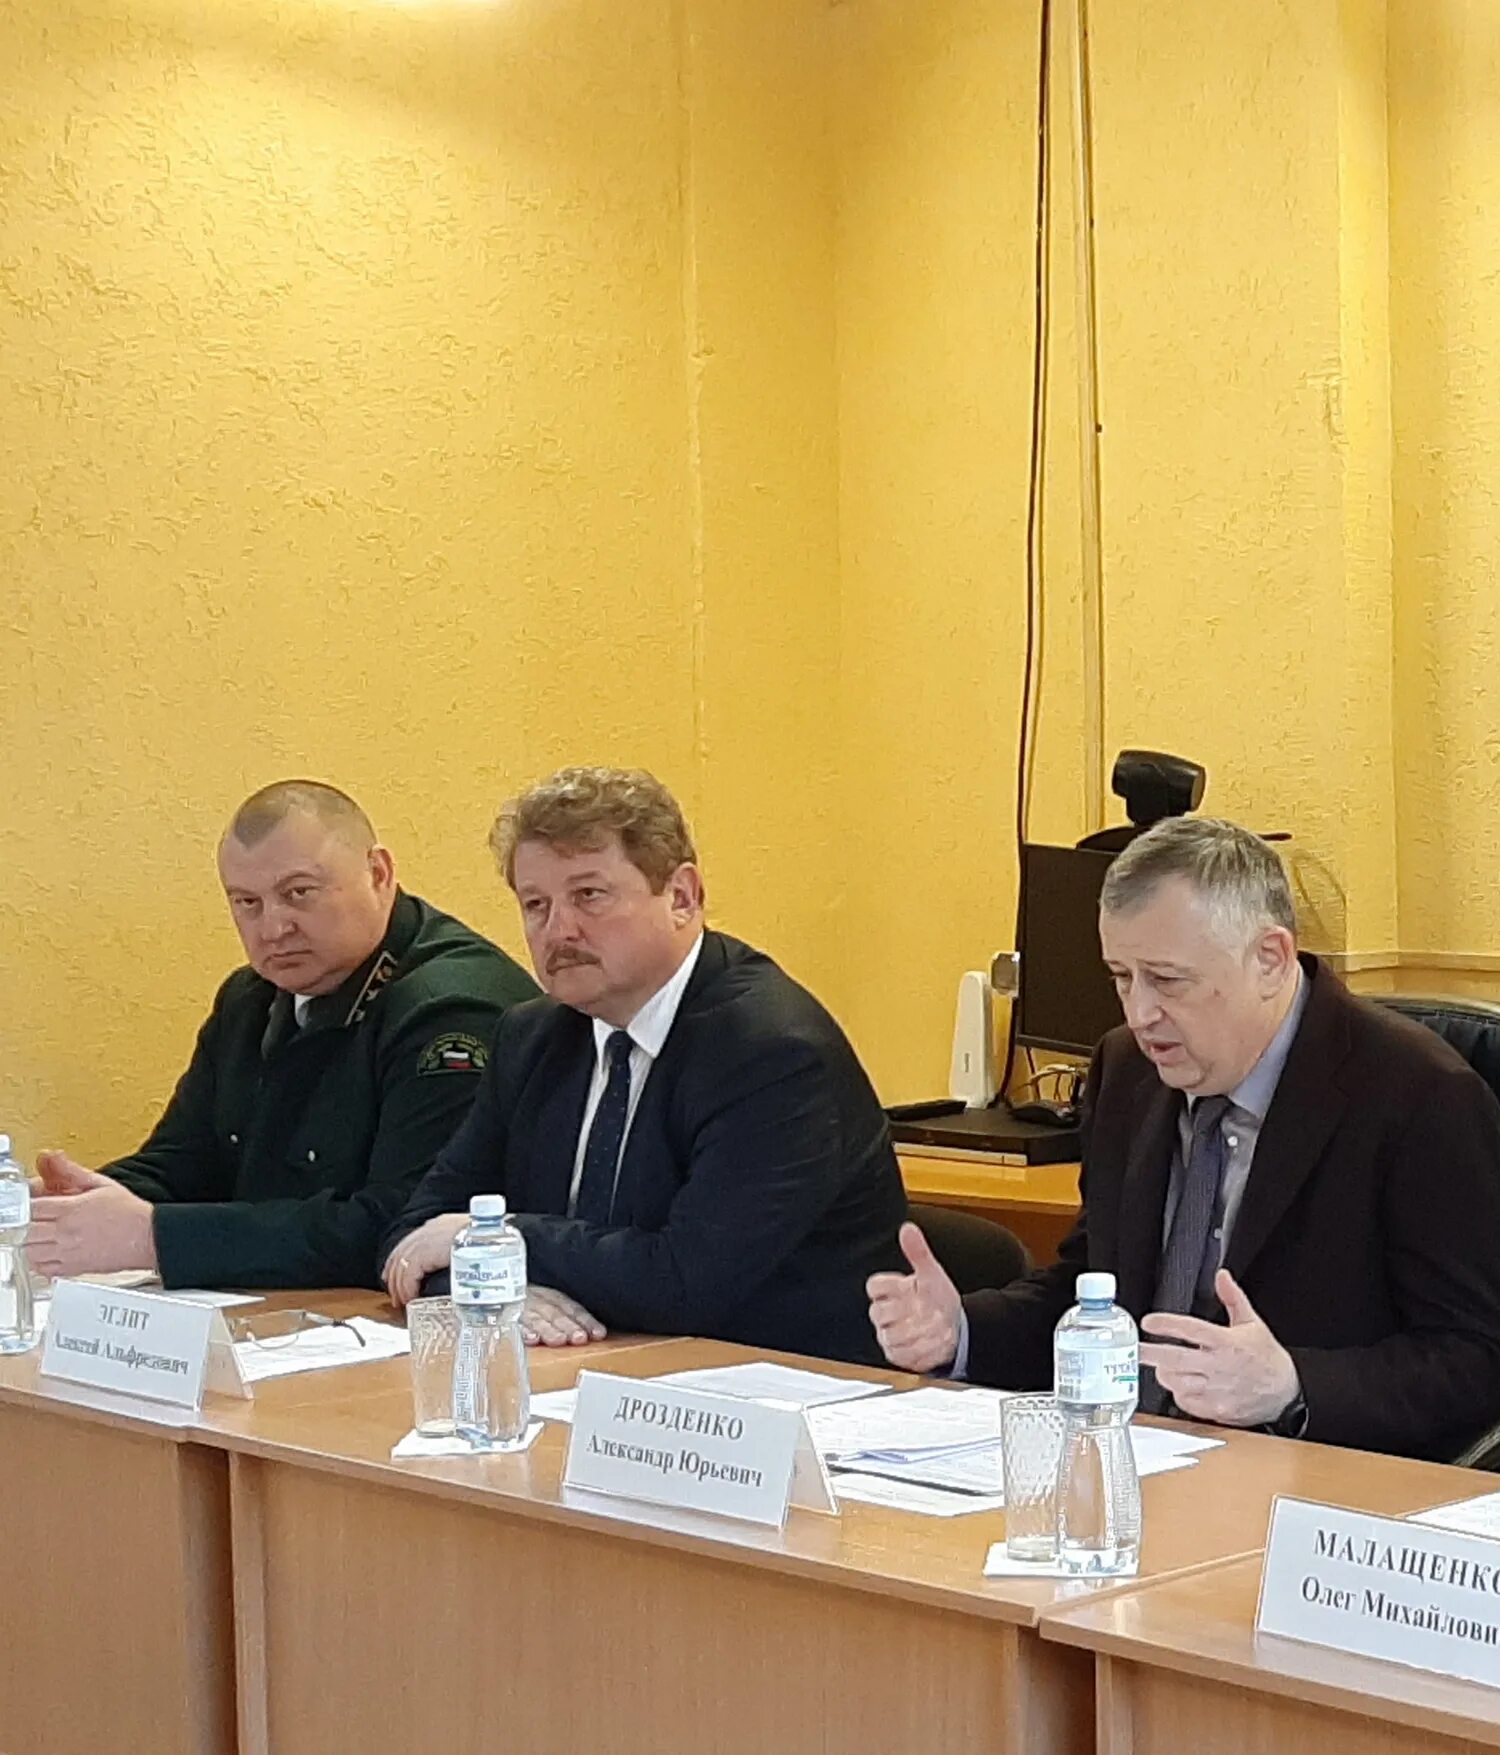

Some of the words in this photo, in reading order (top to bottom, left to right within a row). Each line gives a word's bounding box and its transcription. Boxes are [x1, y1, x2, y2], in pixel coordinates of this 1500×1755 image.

[613, 1396, 744, 1441] ДРОЗДЕНКО
[586, 1434, 674, 1475] Александр
[678, 1449, 763, 1487] Юрьевич
[1302, 1576, 1357, 1611] Олег
